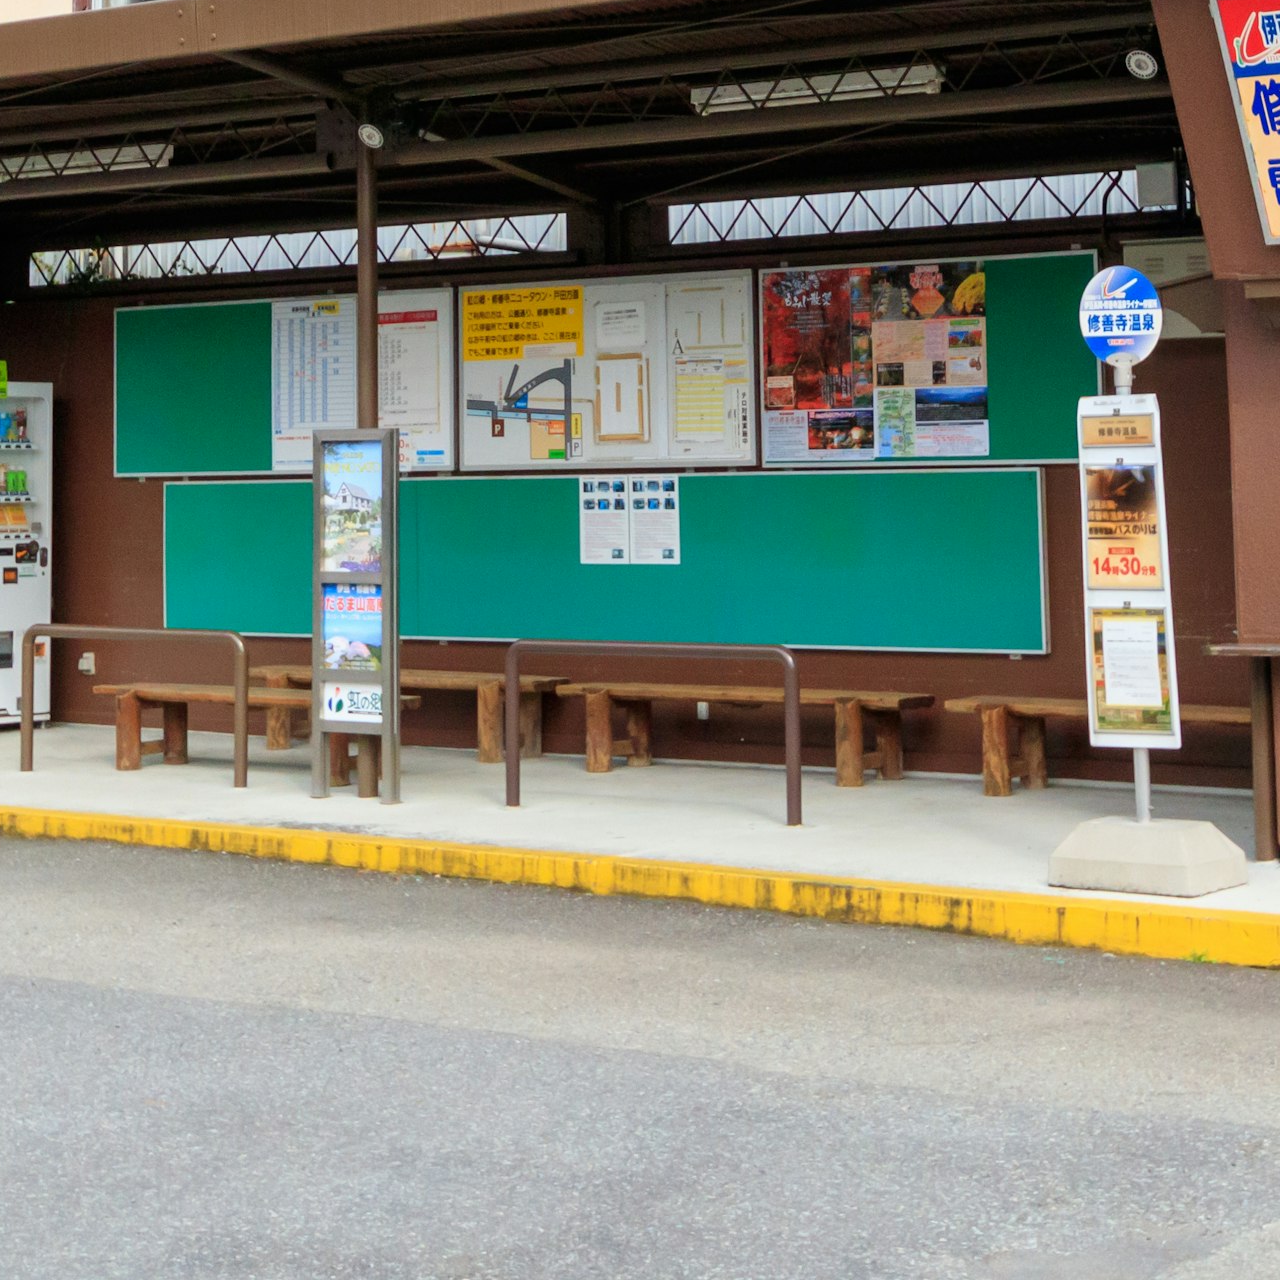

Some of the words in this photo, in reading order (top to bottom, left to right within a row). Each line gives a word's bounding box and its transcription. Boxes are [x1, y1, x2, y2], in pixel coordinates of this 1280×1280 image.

[1087, 312, 1155, 333] 修善寺温泉
